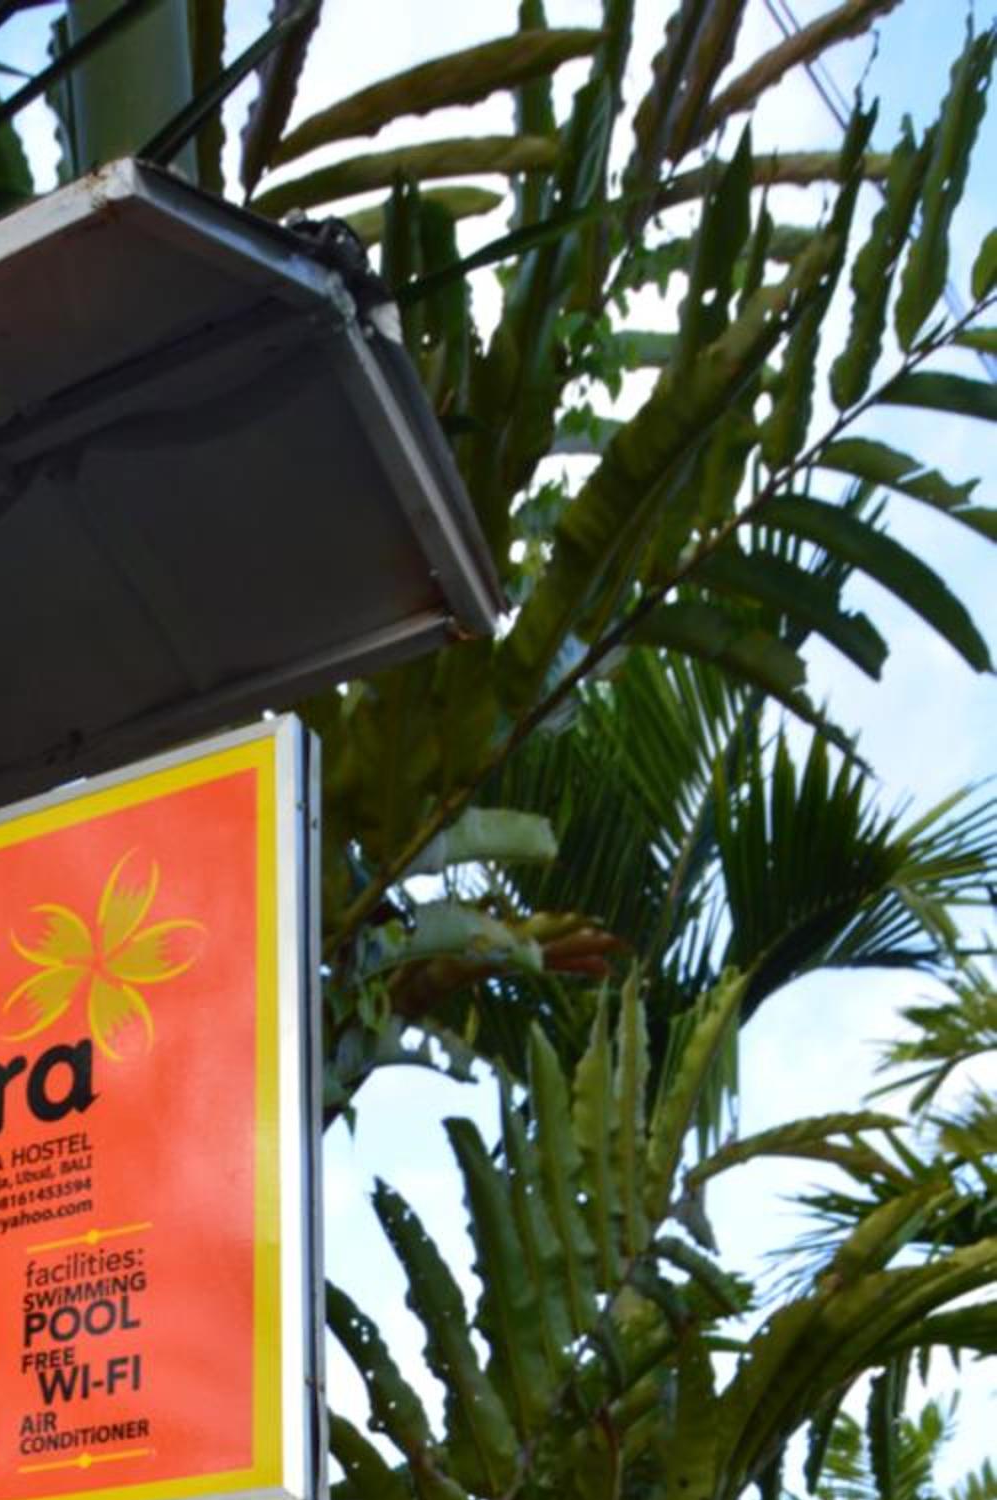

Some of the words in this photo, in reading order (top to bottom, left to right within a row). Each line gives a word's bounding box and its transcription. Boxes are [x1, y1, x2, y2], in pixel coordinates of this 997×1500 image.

[11, 1132, 92, 1168] HOSTEL
[60, 1154, 92, 1176] BALI
[26, 1248, 145, 1289] facilities:
[23, 1295, 141, 1348] POOL
[21, 1347, 76, 1375] FREE
[37, 1354, 141, 1405] WI-FI
